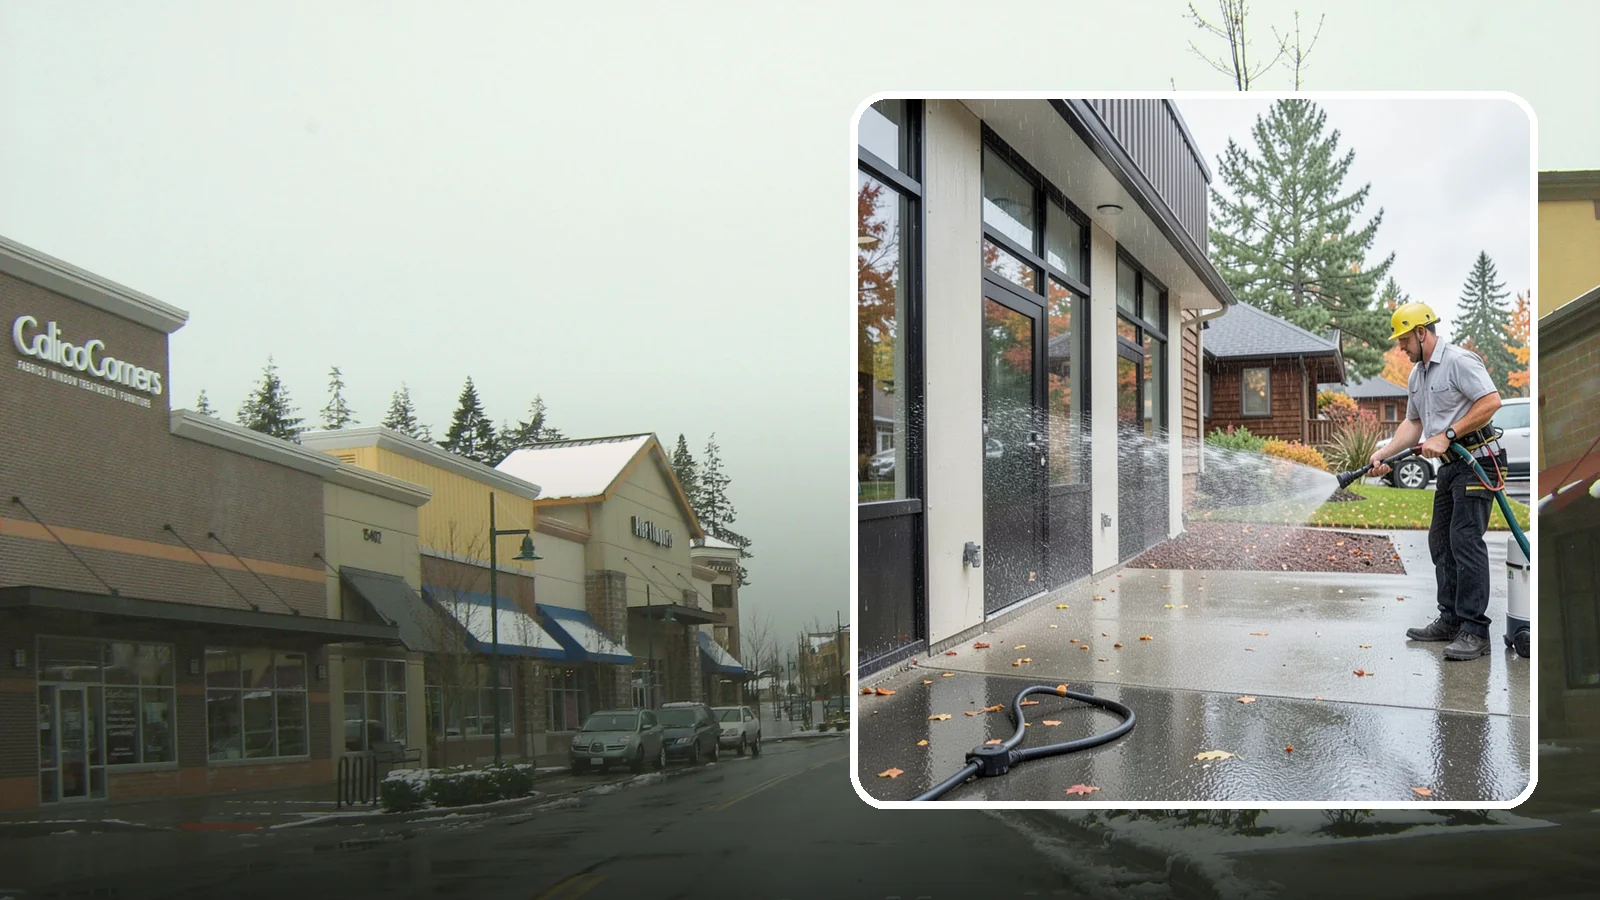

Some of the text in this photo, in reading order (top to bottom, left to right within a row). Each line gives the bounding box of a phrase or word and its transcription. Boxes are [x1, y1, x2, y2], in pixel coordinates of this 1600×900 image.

[17, 360, 47, 377] FABRICS
[50, 369, 78, 386] WINDOW
[79, 378, 117, 399] TREATMENTS
